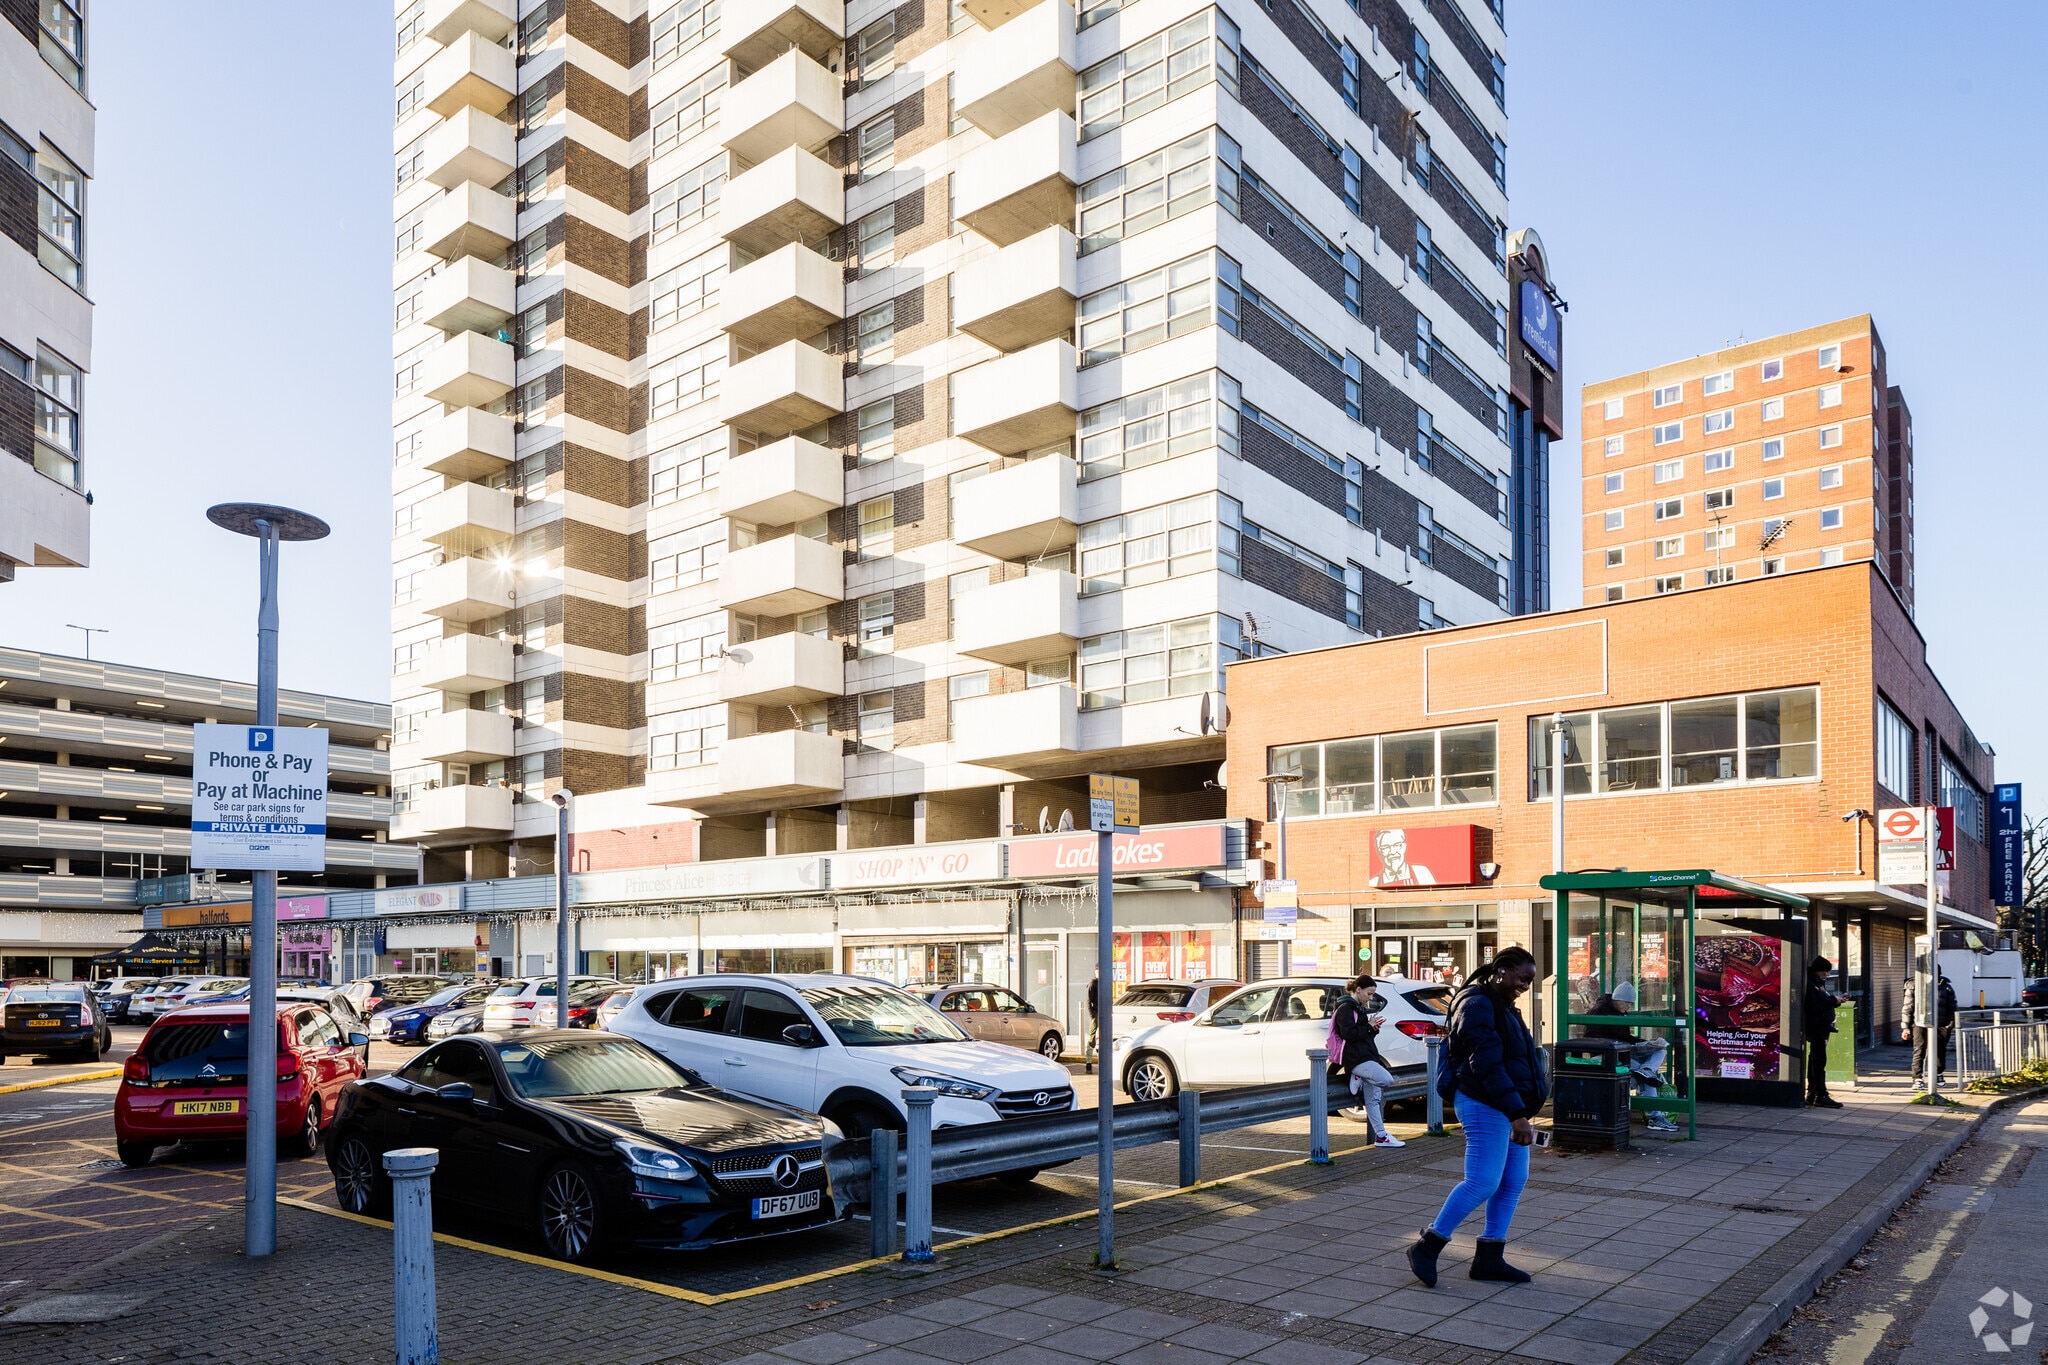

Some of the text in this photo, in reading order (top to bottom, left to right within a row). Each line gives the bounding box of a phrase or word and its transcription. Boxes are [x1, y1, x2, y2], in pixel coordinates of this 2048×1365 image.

[1524, 316, 1557, 362] Premier Inn
[254, 732, 268, 748] P
[209, 752, 313, 774] Phone & Pay
[252, 770, 269, 782] or
[197, 782, 323, 801] Pay at Machine
[2002, 788, 2014, 800] P
[214, 802, 228, 811] See
[247, 803, 266, 813] park
[268, 804, 291, 814] signs
[294, 804, 305, 813] for
[220, 813, 298, 824] terms & conditions
[211, 822, 306, 834] PRIVATE LAND
[1055, 838, 1165, 868] Ladokes
[856, 858, 904, 879] SHOP
[942, 853, 969, 874] GO
[625, 870, 751, 893] Princess Alice Hospice
[2004, 862, 2013, 902] PARKING
[388, 896, 416, 907] ELEGANT
[420, 894, 440, 906] NAILS
[200, 909, 230, 924] halfords
[1145, 962, 1168, 972] EVERY
[1186, 968, 1206, 979] EVER
[1112, 968, 1126, 982] VER
[1706, 1030, 1733, 1039] Helping
[1708, 1038, 1766, 1048] Christmas spirit.
[181, 1101, 232, 1113] HK17 NBB
[761, 1192, 818, 1216] DF67 UUB
